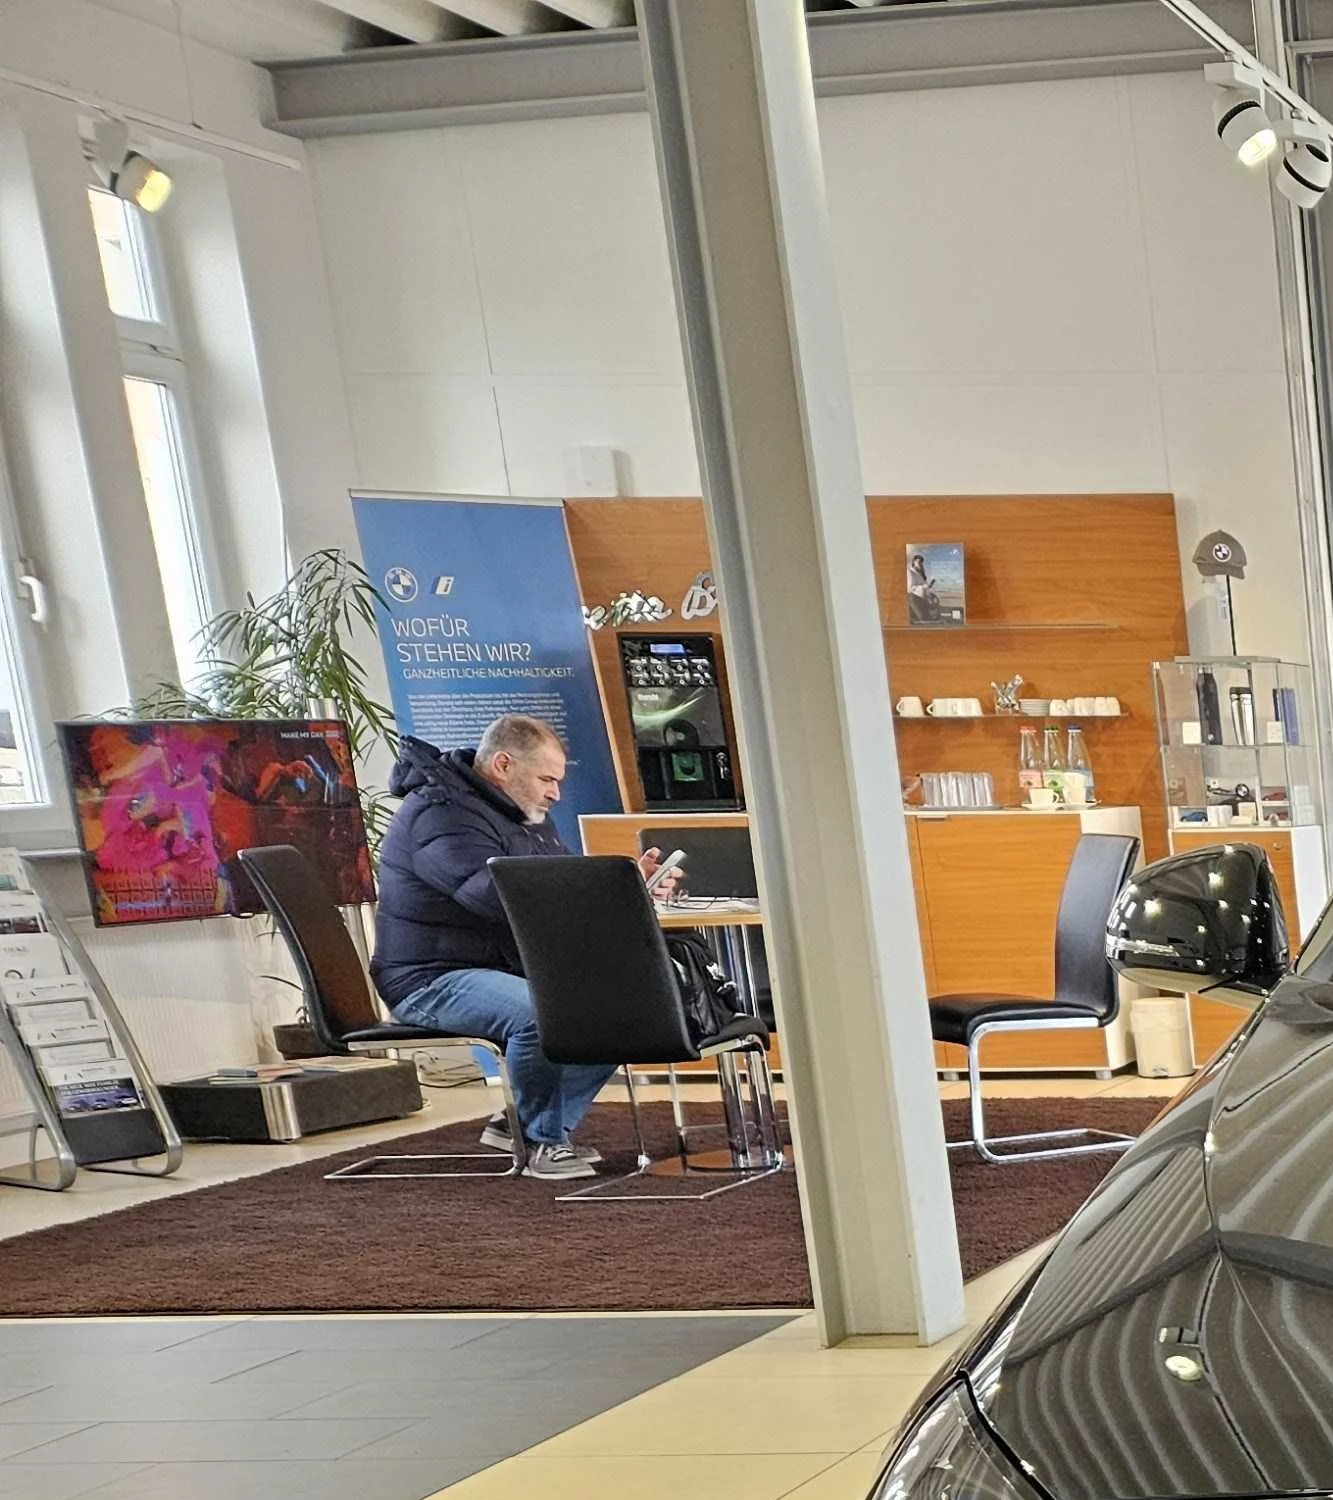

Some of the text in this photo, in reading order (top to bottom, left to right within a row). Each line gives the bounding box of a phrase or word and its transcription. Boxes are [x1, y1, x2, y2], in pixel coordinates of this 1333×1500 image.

[391, 613, 470, 637] WOFÜR
[396, 643, 532, 663] STEHEN WIR?
[403, 666, 575, 680] GANZHEITLICHE NACHHALTIGKEIT.
